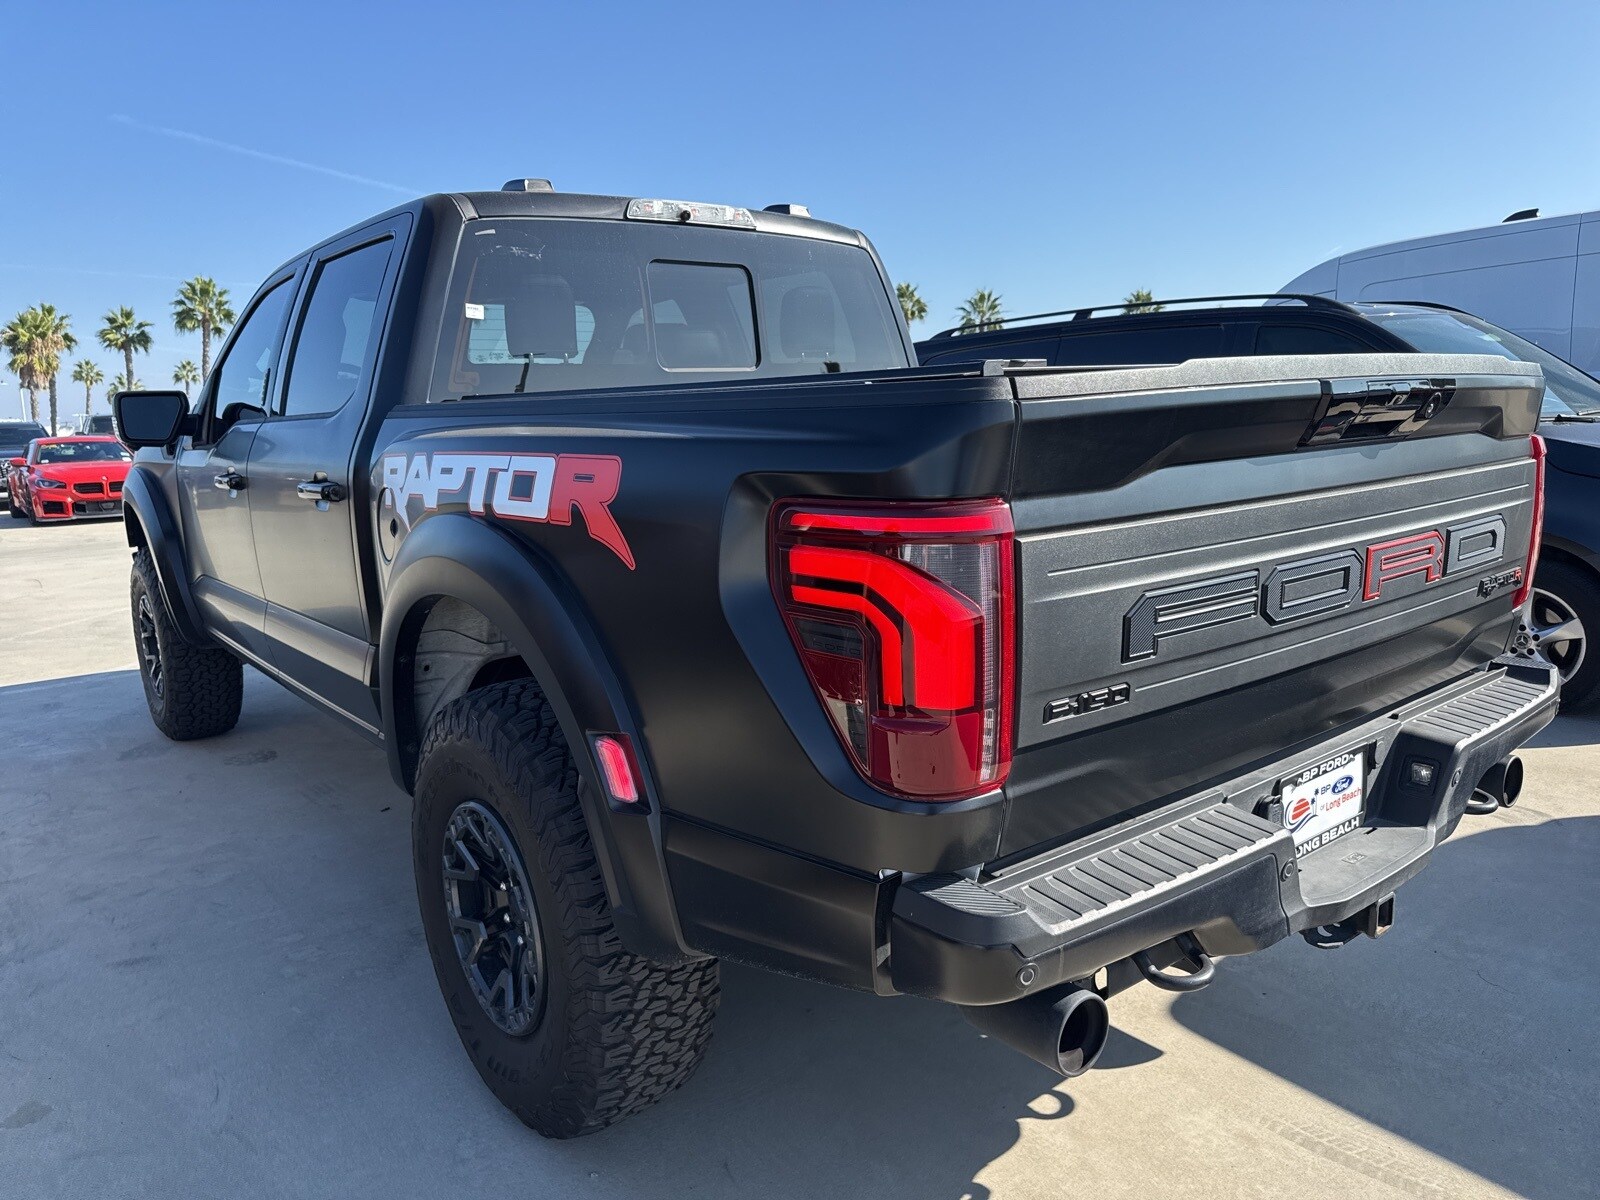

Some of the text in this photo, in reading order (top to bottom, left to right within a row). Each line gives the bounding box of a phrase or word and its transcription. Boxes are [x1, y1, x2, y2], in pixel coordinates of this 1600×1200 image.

[383, 451, 636, 571] RAPTOR
[1120, 513, 1508, 664] FORD
[1302, 754, 1349, 781] BP FORD
[1320, 784, 1331, 795] BP
[1326, 798, 1341, 811] Long
[1342, 787, 1362, 803] Beach
[1295, 817, 1359, 858] ONG BEACH
